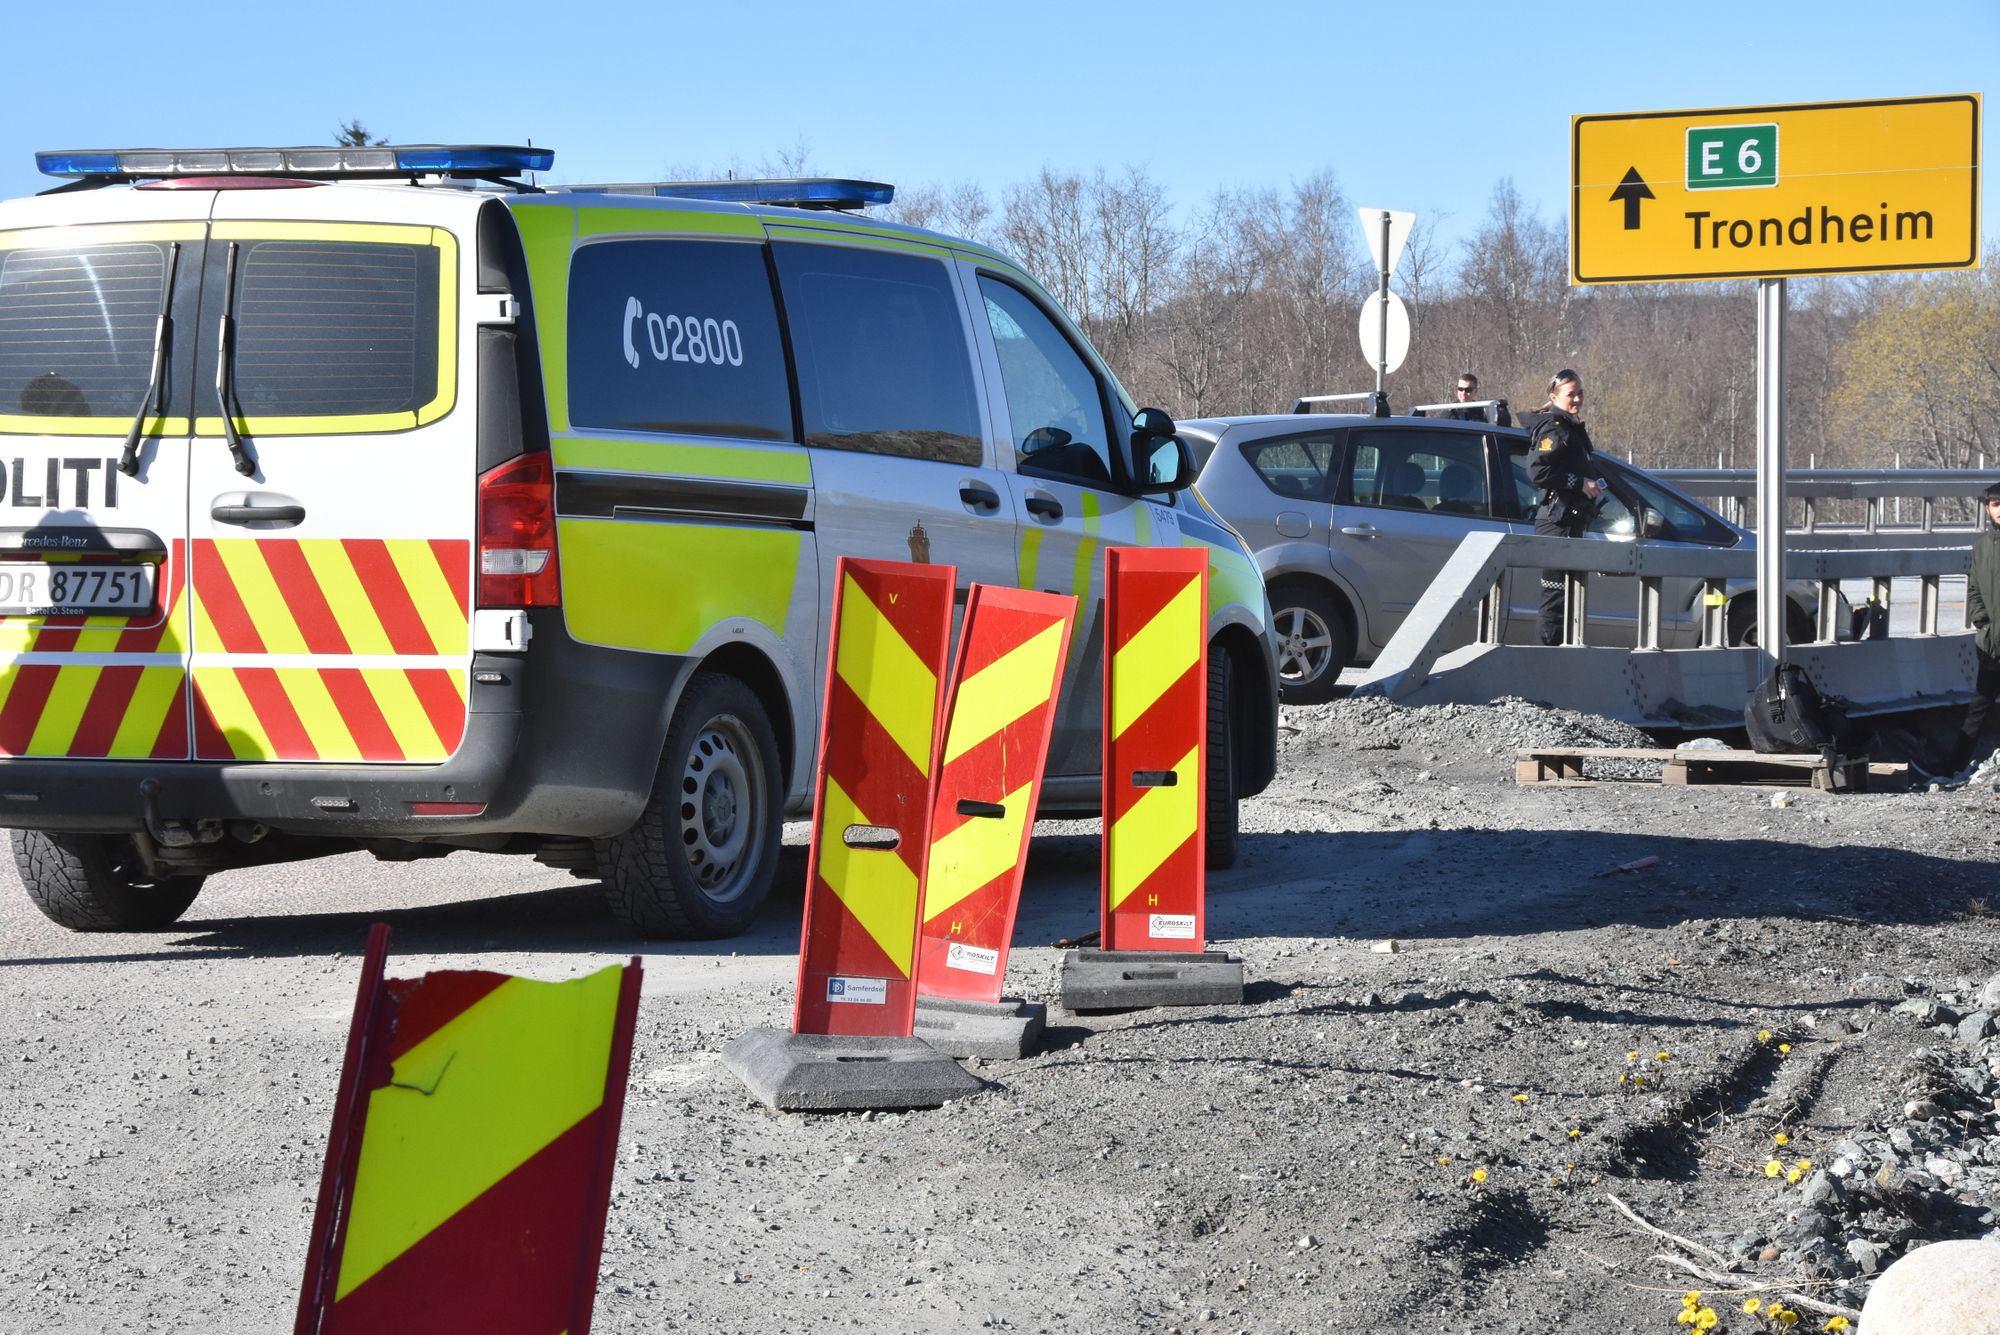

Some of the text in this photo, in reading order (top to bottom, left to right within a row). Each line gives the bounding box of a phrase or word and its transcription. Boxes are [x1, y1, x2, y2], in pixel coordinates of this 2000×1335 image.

[1702, 138, 1762, 175] E 6
[1685, 202, 1934, 250] Trondheim
[646, 312, 743, 367] 02800
[0, 458, 118, 508] LITI
[51, 571, 142, 603] 87751
[26, 607, 84, 615] Bertel O. Steen
[1148, 894, 1158, 906] H
[951, 921, 962, 934] H
[957, 949, 995, 961] EROSKILT
[847, 985, 885, 993] Samferdsel
